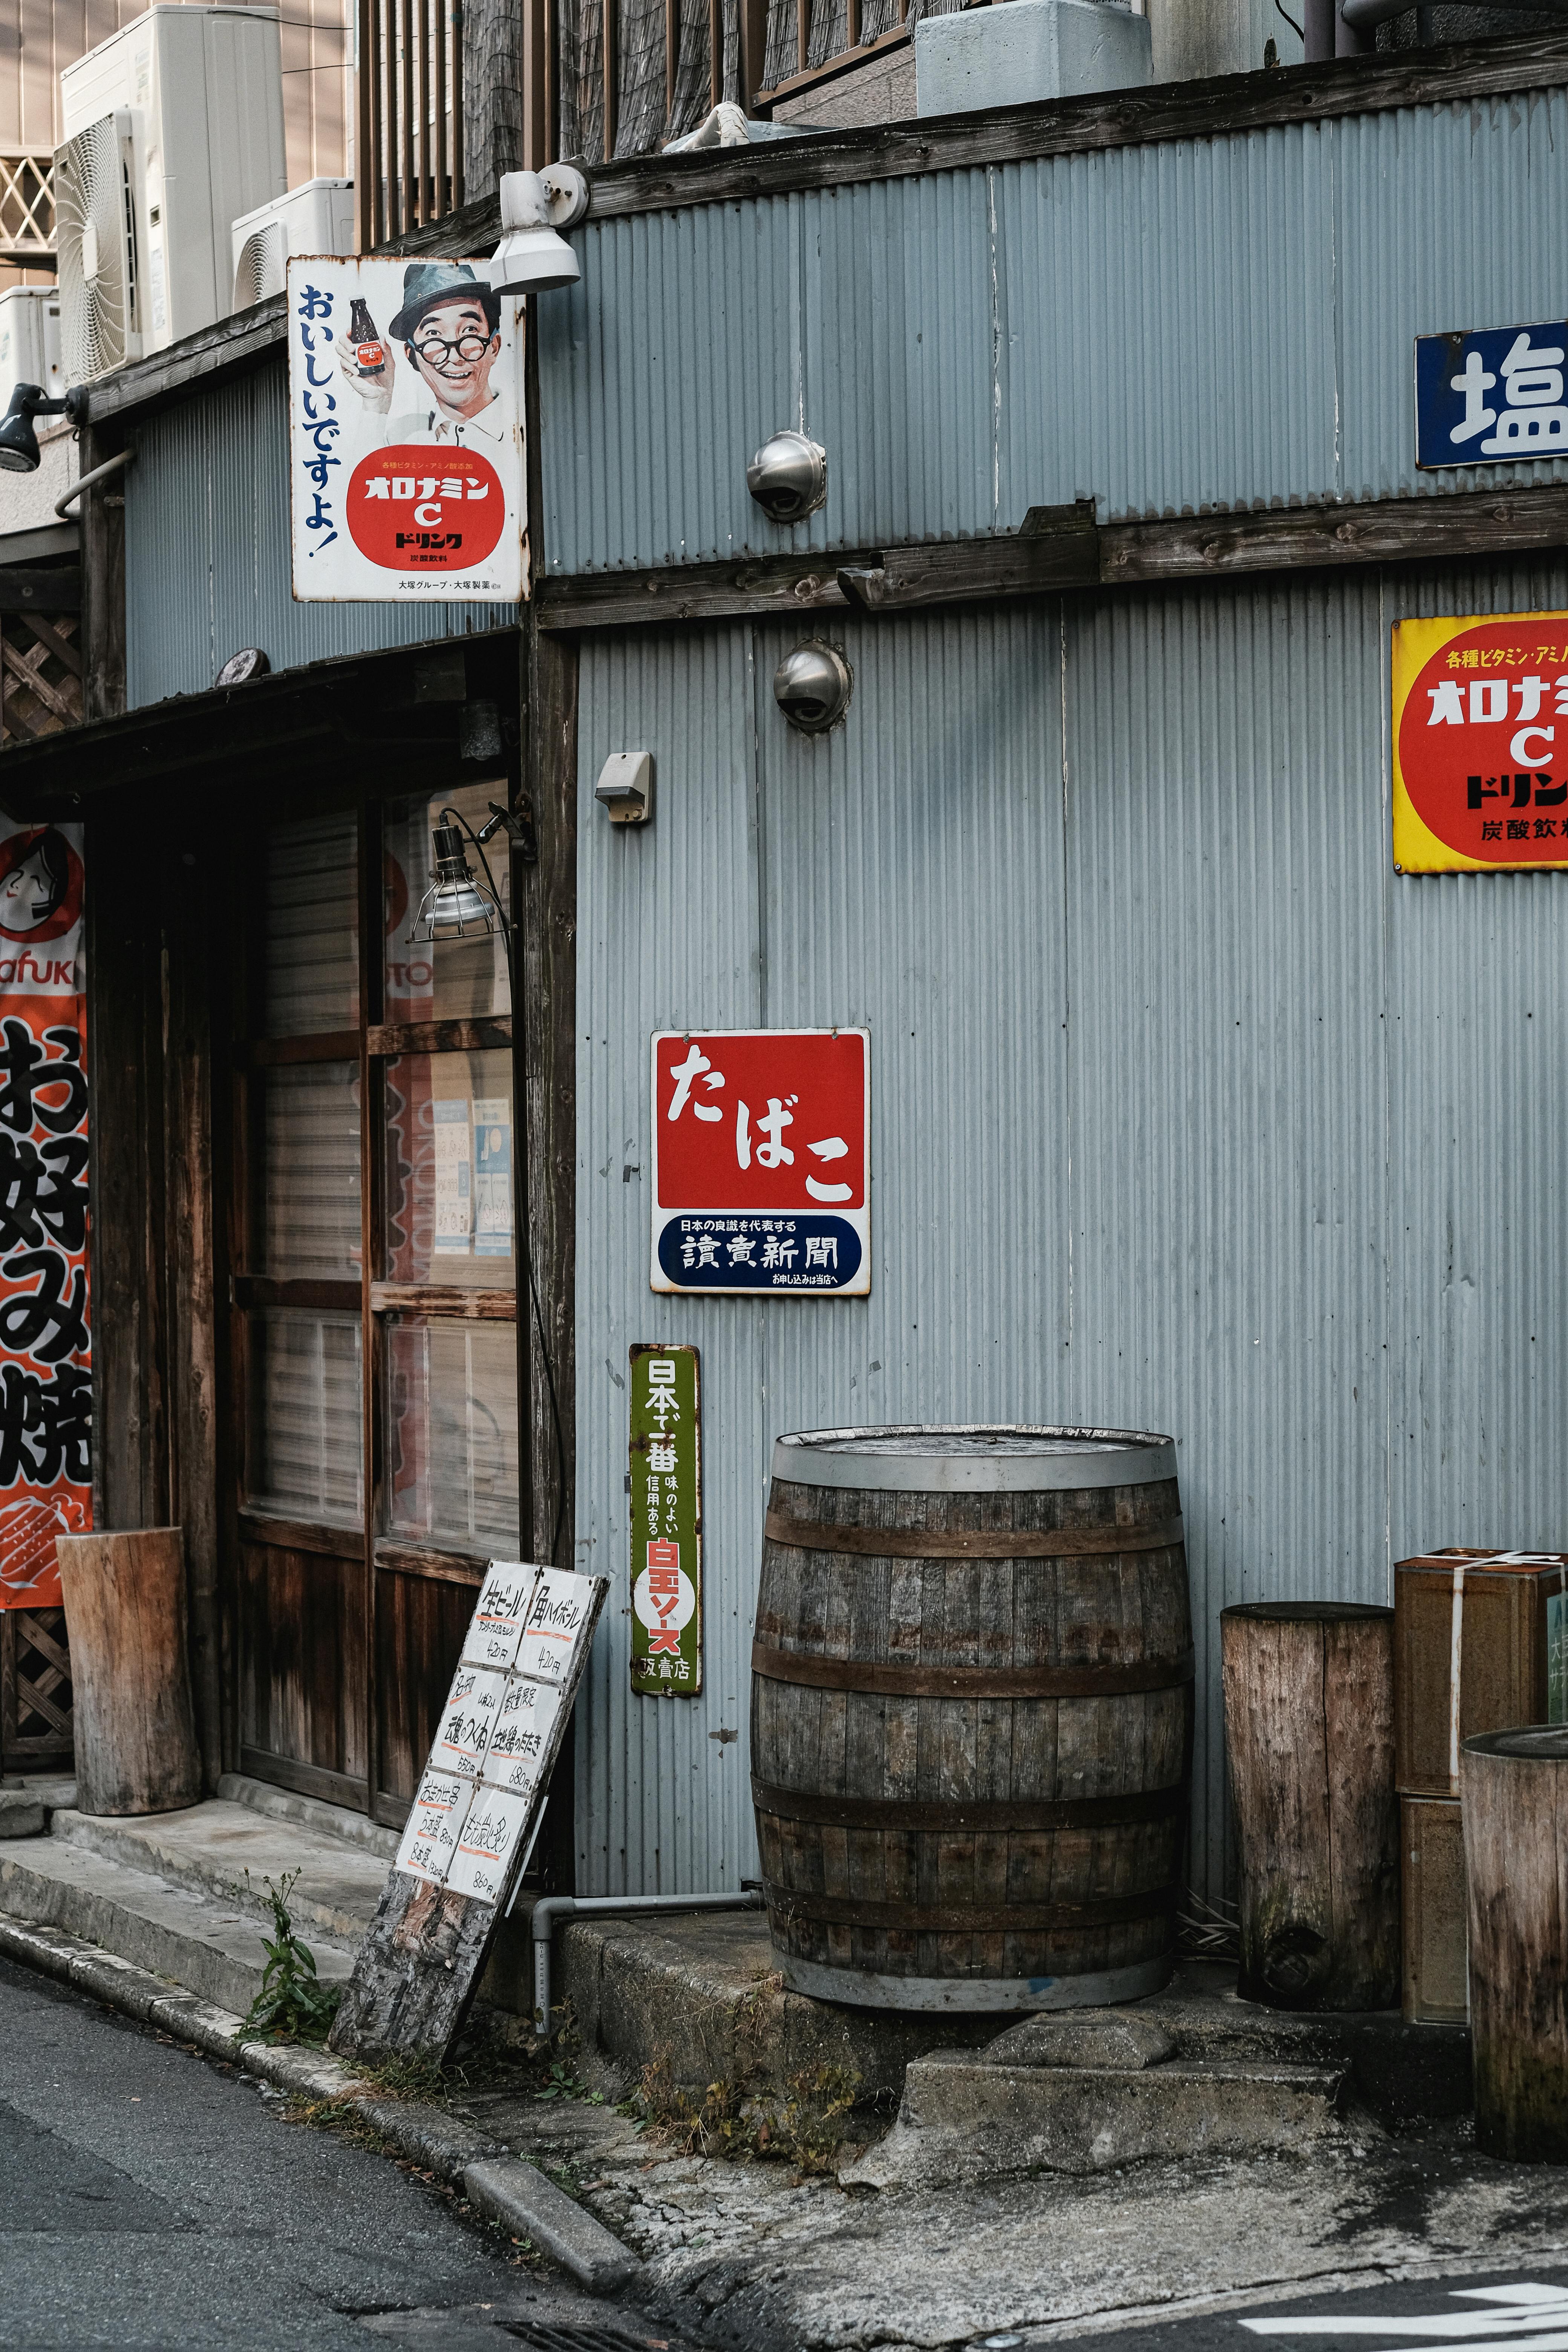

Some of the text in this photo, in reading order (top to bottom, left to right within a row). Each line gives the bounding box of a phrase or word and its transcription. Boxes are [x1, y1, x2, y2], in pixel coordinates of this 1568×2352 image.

[1450, 332, 1568, 454] 塩
[298, 284, 341, 557] おいしいですよ!
[364, 476, 489, 500] オロナミン
[414, 503, 443, 527] C
[396, 533, 462, 550] ドリンク
[1510, 726, 1554, 767] C
[1467, 773, 1568, 809] ドリン
[668, 1044, 853, 1202] たばこ
[681, 1220, 796, 1232] 日本の良識を代表する
[773, 1274, 838, 1285] お申し込みは当店へ
[645, 1360, 681, 1472] 日本で一番
[646, 1475, 660, 1535] 信用ある
[665, 1475, 679, 1533] 味のよい
[481, 1579, 527, 1618] 生ビール
[528, 1585, 581, 1629] 角ハイボール
[647, 1537, 680, 1655] 白玉ソース
[487, 1639, 508, 1661] 420円
[538, 1646, 560, 1674] 420円
[452, 1673, 476, 1698] 名物
[504, 1686, 536, 1713] 数量限定
[444, 1712, 489, 1752] 魂のつくね
[491, 1725, 542, 1757] 地鶏のたたき
[457, 1755, 475, 1773] 550円
[509, 1765, 530, 1790] 680円
[420, 1779, 460, 1808] おまかせ串
[420, 1809, 444, 1838] 5本盛
[463, 1813, 510, 1853] もも炭火炙り
[411, 1842, 432, 1868] 8本盛
[473, 1871, 493, 1895] 860円
